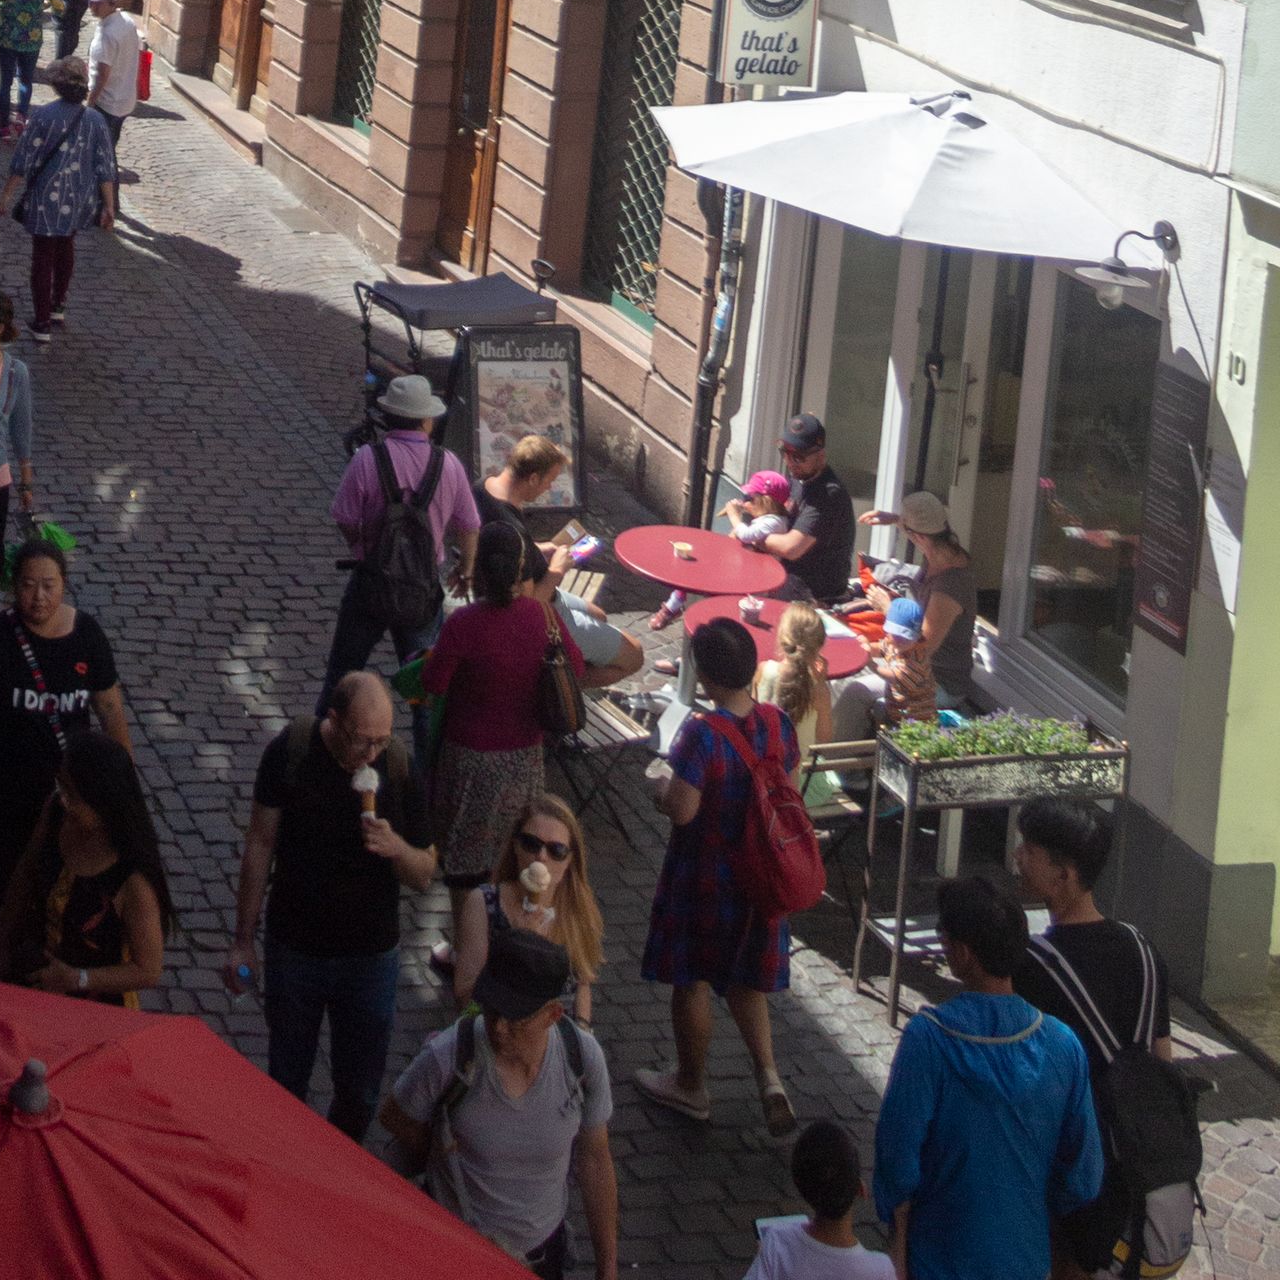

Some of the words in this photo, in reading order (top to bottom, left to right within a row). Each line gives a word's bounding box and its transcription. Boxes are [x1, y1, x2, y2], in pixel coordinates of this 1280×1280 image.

[740, 30, 799, 53] that's
[735, 53, 801, 80] gelato
[480, 341, 522, 358] that's
[523, 341, 567, 361] gelato
[1228, 350, 1246, 386] 10
